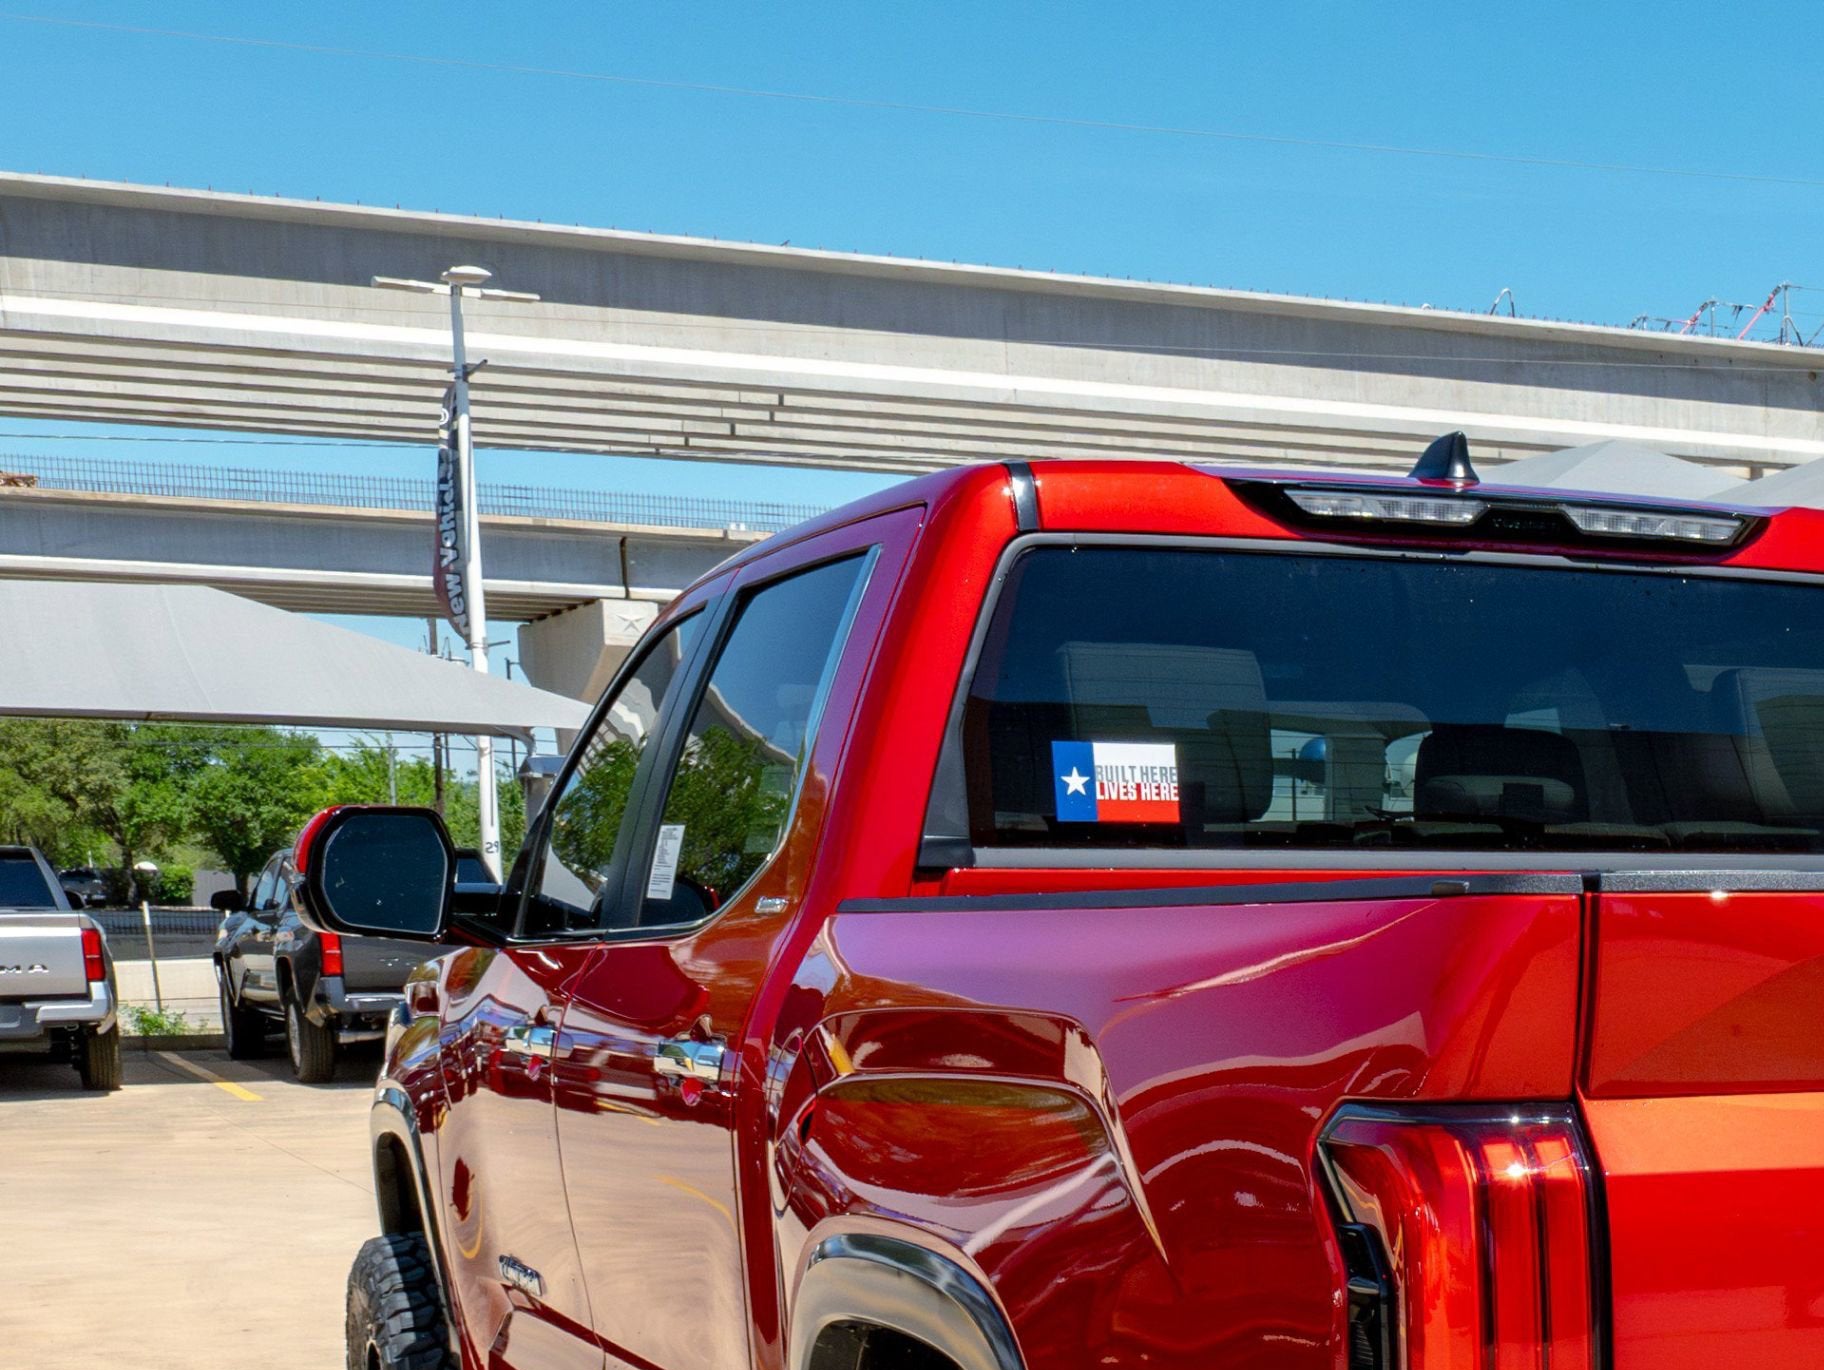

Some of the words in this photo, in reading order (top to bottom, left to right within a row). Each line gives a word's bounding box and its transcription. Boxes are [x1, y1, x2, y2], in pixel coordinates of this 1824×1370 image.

[1095, 765, 1136, 783] BUILT
[1140, 766, 1178, 784] HERE
[1096, 782, 1137, 800] LIVES
[1141, 782, 1179, 801] HERE
[485, 840, 499, 854] 29
